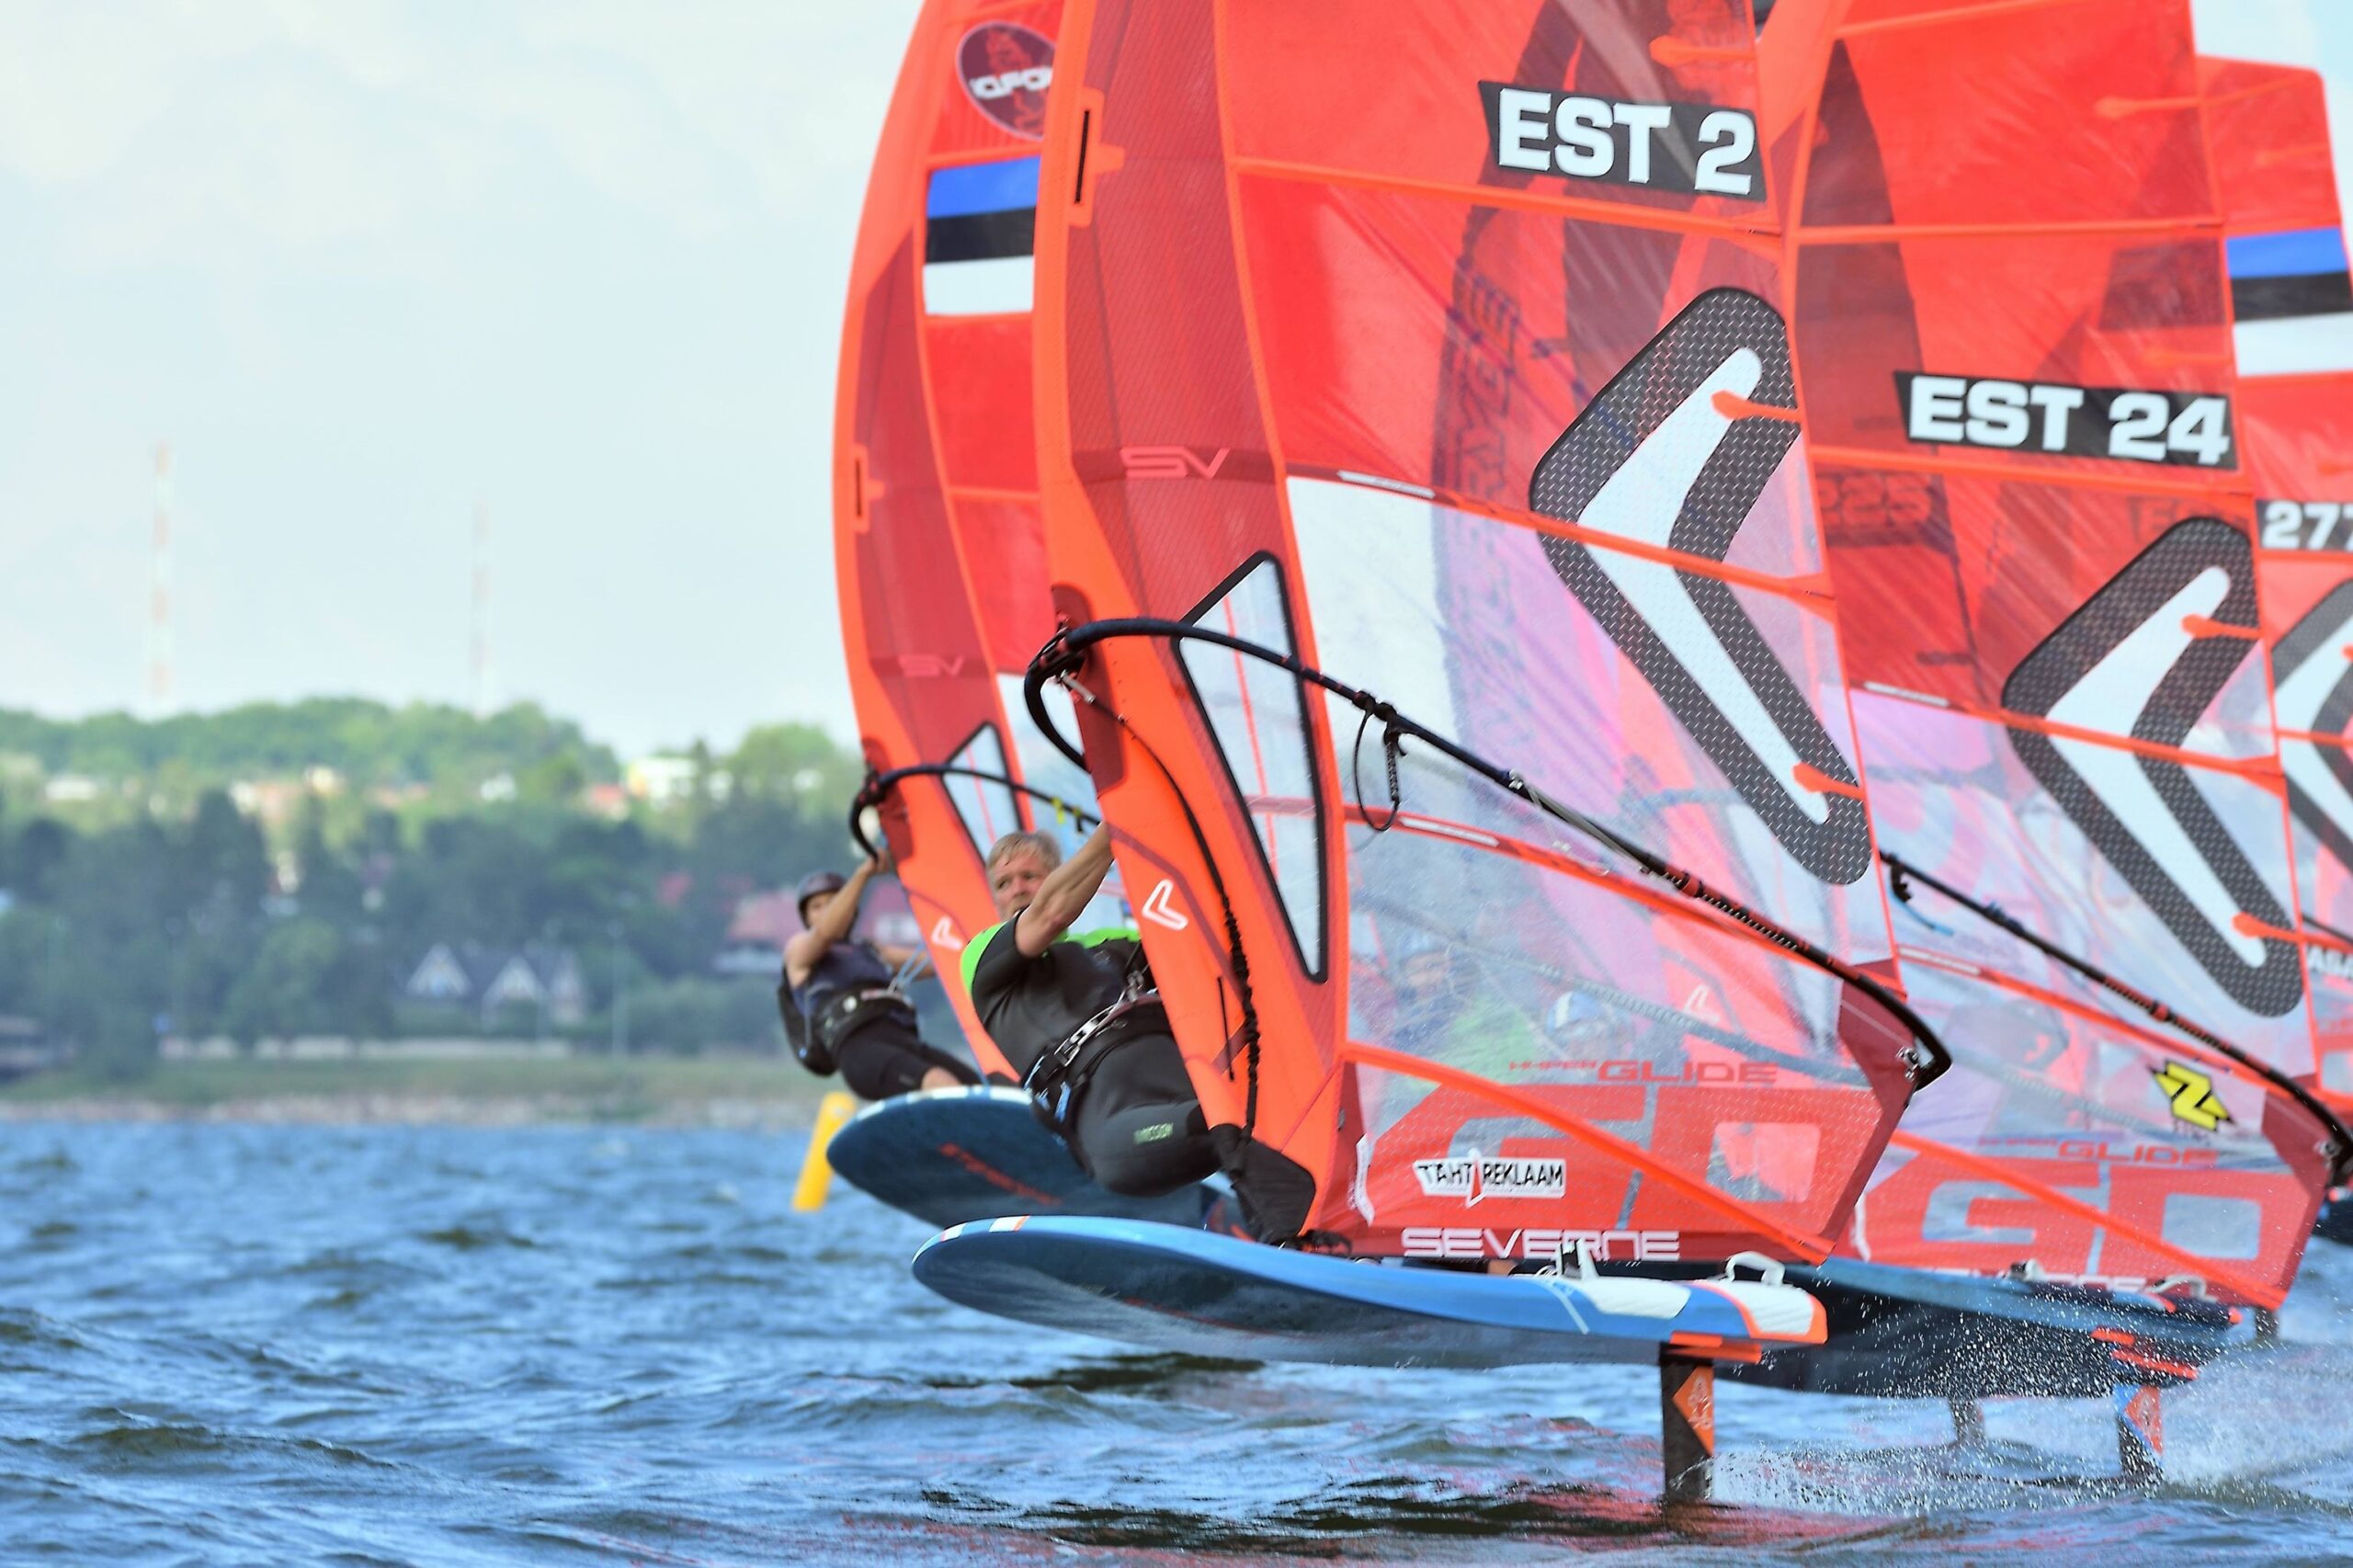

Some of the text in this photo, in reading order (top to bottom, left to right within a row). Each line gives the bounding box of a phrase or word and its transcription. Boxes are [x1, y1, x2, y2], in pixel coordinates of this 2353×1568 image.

[1498, 87, 1756, 195] EST 2
[1908, 376, 2231, 464] EST 24
[1597, 1060, 1778, 1083] GLIDE
[1402, 1227, 1681, 1261] SEVERNE
